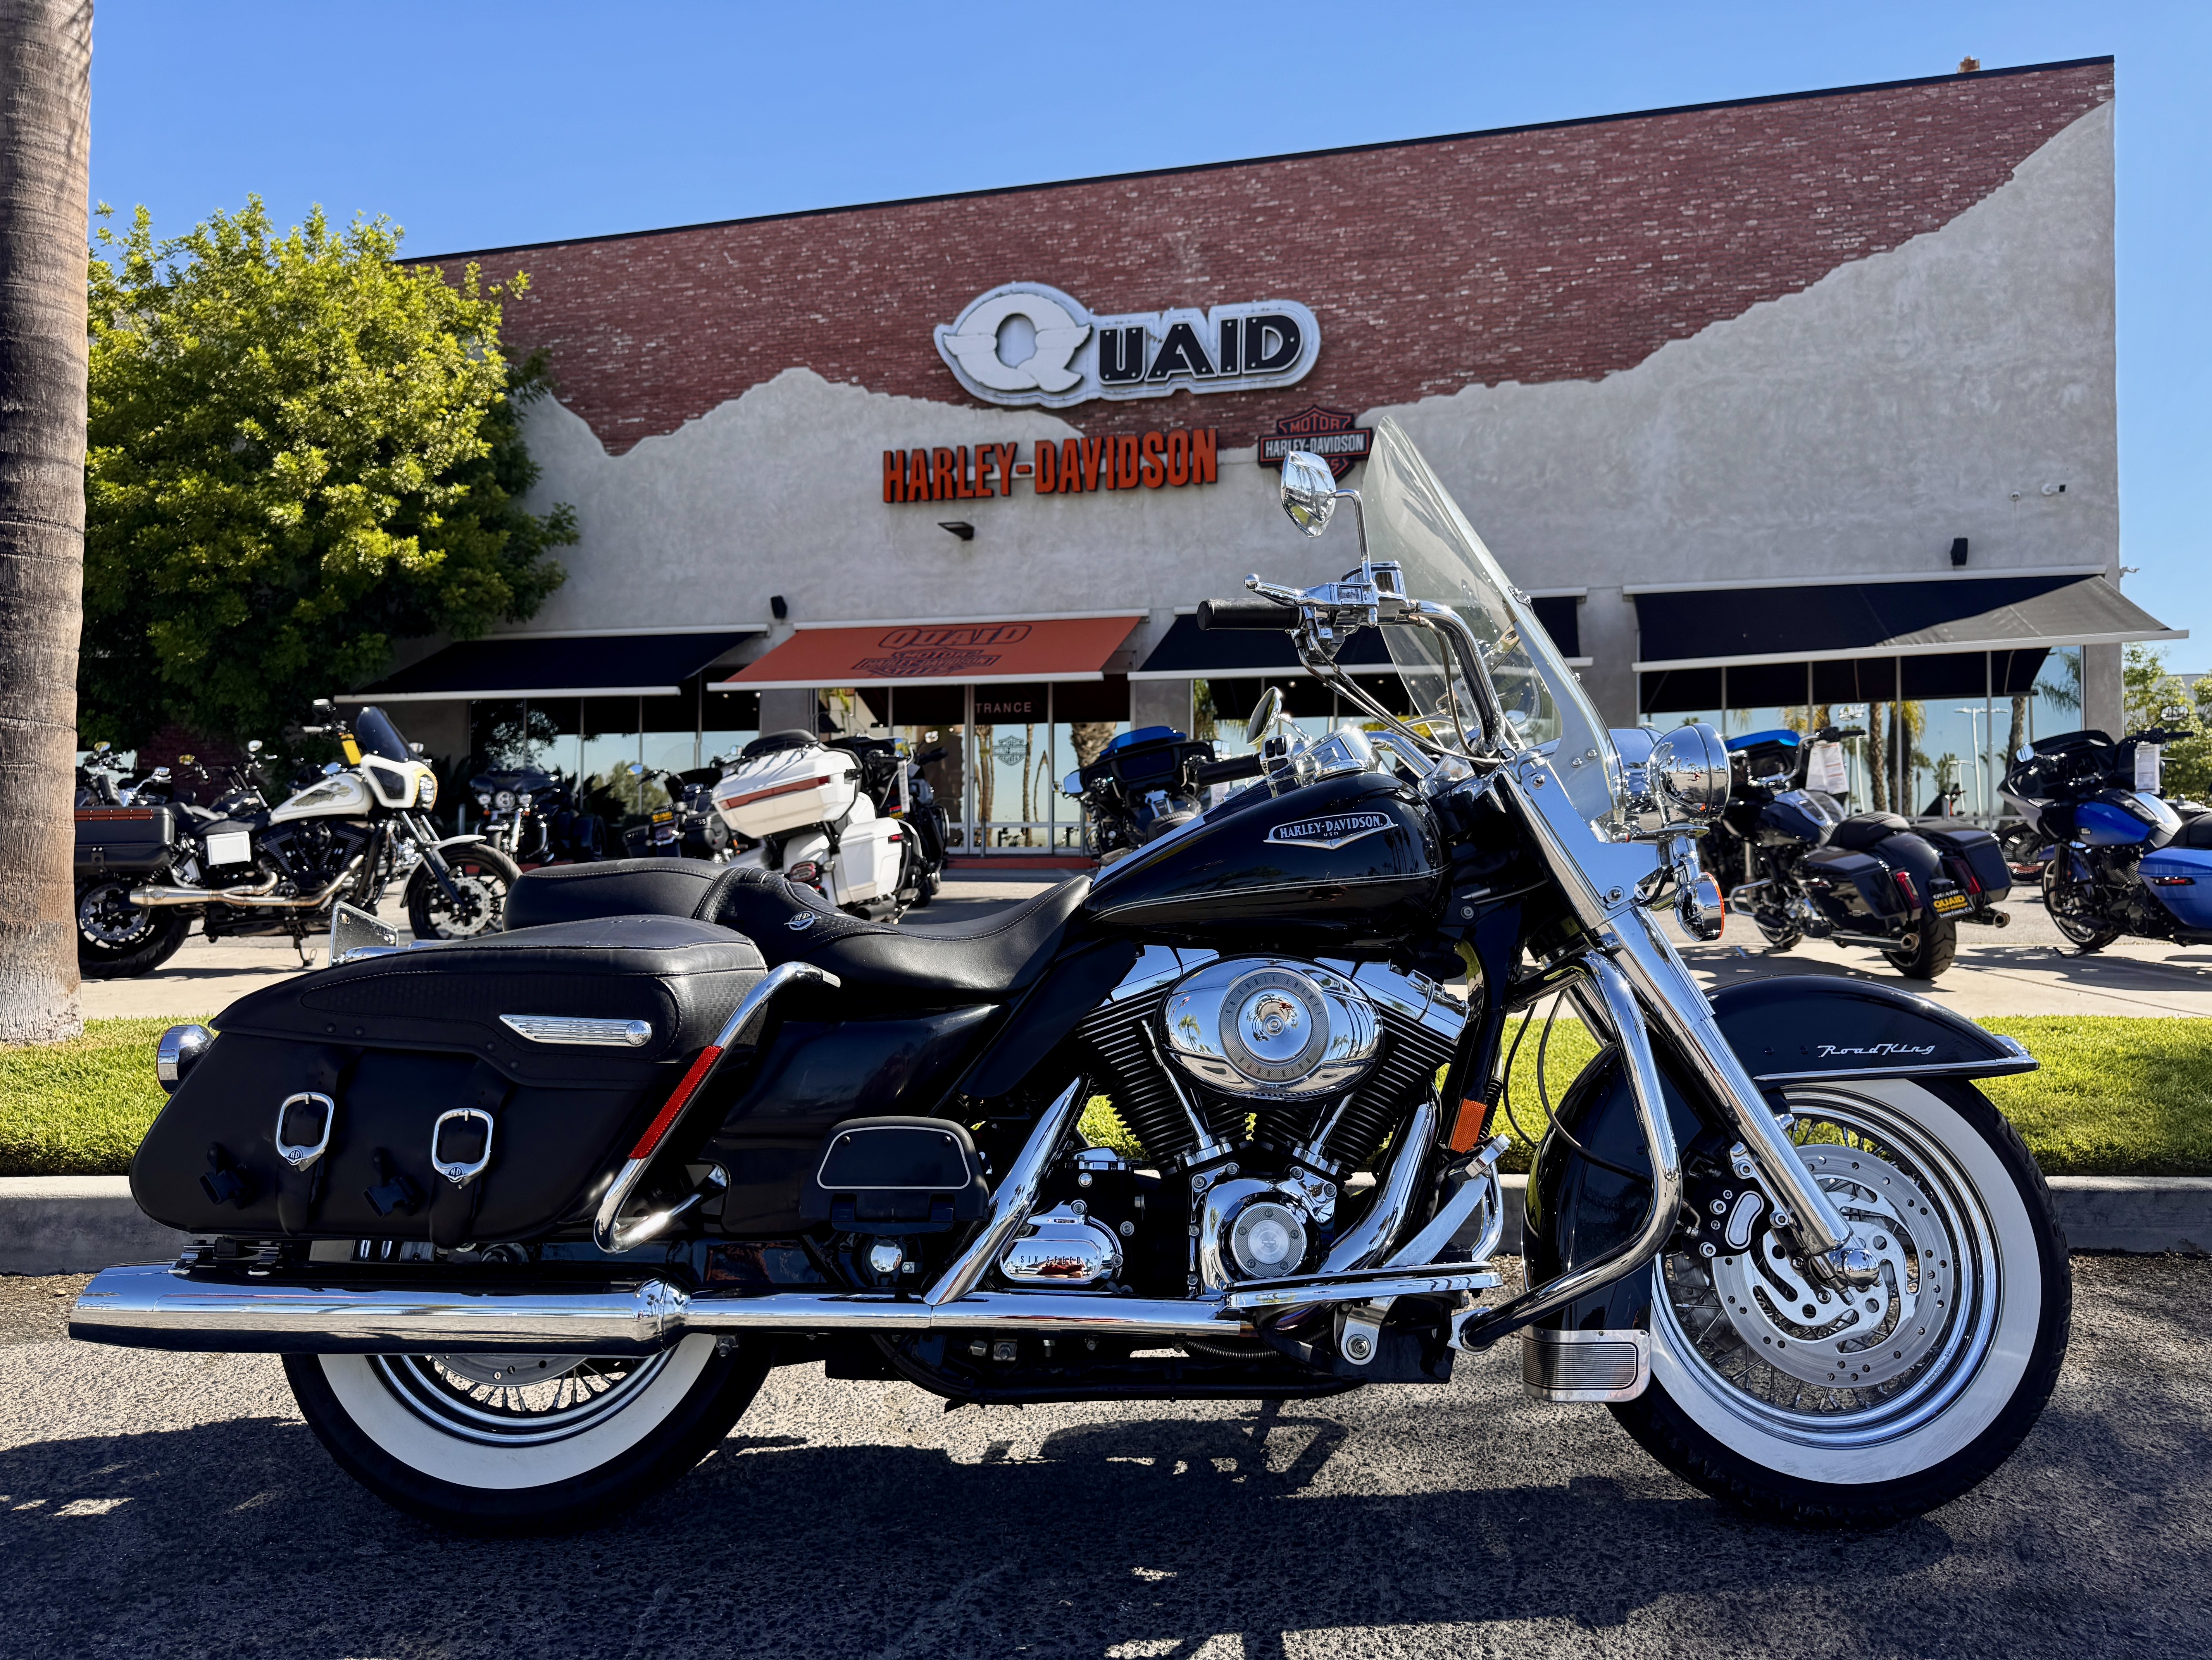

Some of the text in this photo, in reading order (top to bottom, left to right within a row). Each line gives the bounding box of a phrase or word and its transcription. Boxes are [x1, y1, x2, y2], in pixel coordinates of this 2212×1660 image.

[944, 293, 1303, 392] QUAID
[1290, 413, 1340, 433] MOTOR
[1265, 433, 1365, 458] HARLEY-DAVIDSON
[883, 429, 1217, 503] HARLEY-DAVIDSON
[879, 625, 1032, 649] QUAID
[1933, 895, 1965, 908] QUAID
[290, 1150, 300, 1159] H-D
[450, 1168, 461, 1176] H-D
[1020, 1255, 1081, 1265] SIX SPEED
